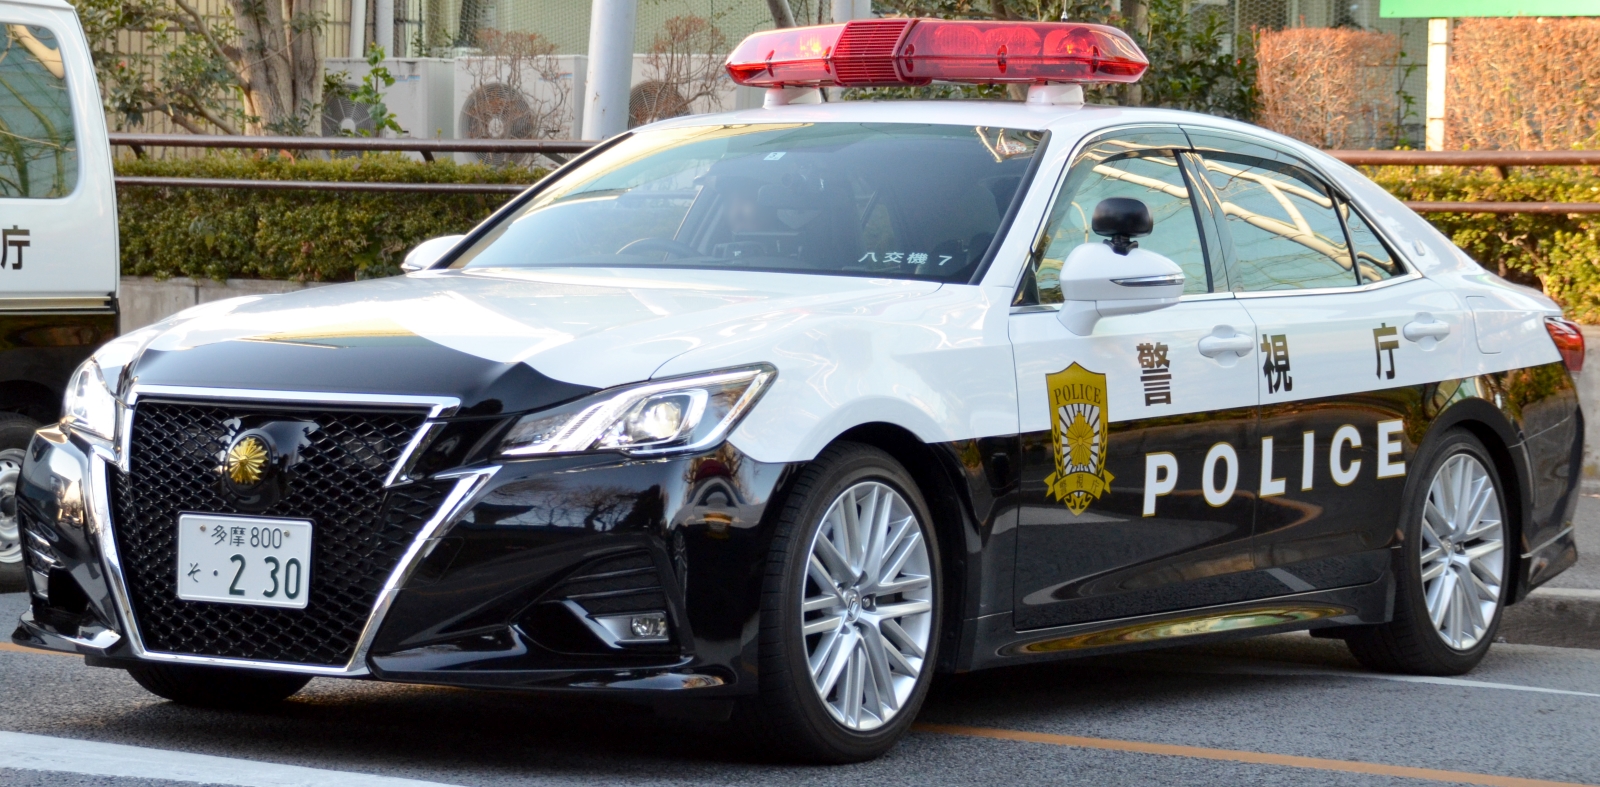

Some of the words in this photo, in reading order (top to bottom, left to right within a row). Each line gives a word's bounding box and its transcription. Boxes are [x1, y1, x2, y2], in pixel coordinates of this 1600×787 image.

[0, 224, 30, 270] 庁
[858, 252, 928, 264] 八交機
[938, 255, 953, 266] 7
[1053, 383, 1101, 405] POLICE
[1142, 418, 1407, 518] POLICE
